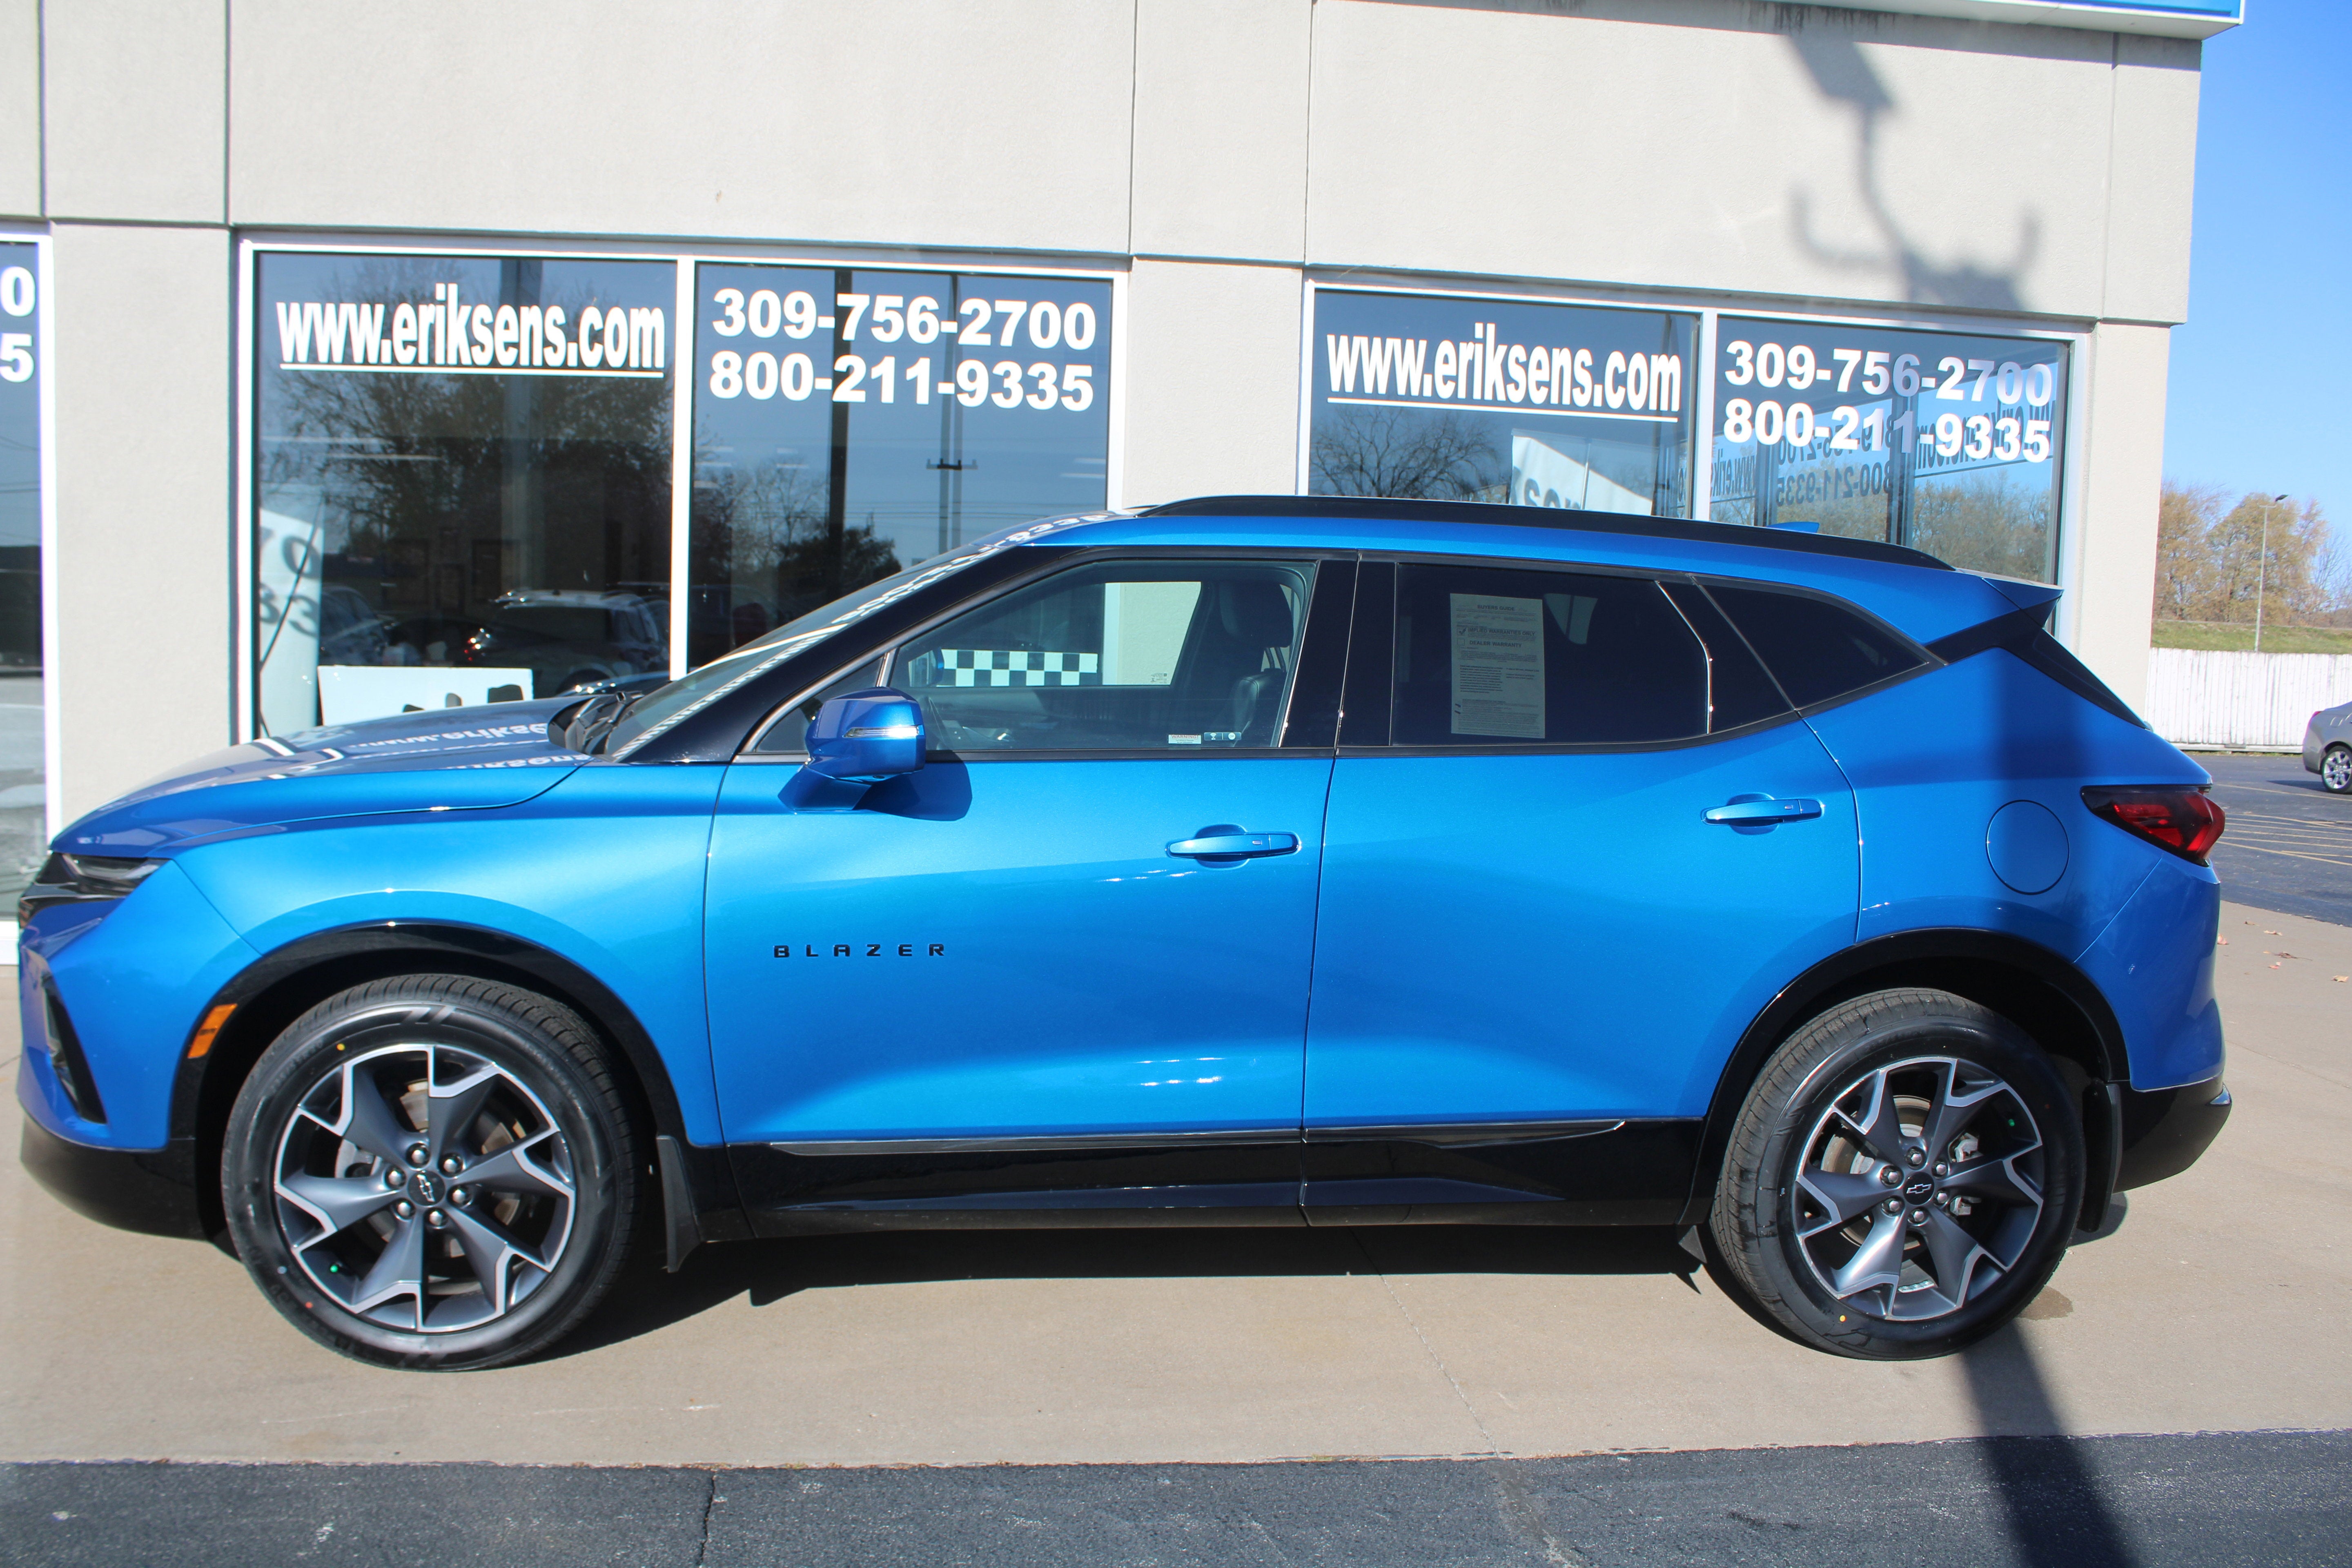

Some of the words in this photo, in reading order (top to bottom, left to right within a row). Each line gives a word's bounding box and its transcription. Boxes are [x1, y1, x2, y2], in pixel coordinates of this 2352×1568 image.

[276, 283, 665, 368] www.eriksens.com
[712, 288, 1096, 350] 309-756-2700
[709, 350, 1094, 412] 800-211-9335
[1327, 322, 1681, 412] www.eriksens.com
[1724, 340, 2053, 407] 309-756-2700
[1723, 398, 2051, 464] 800-211-9335
[773, 944, 944, 958] BLAZER
